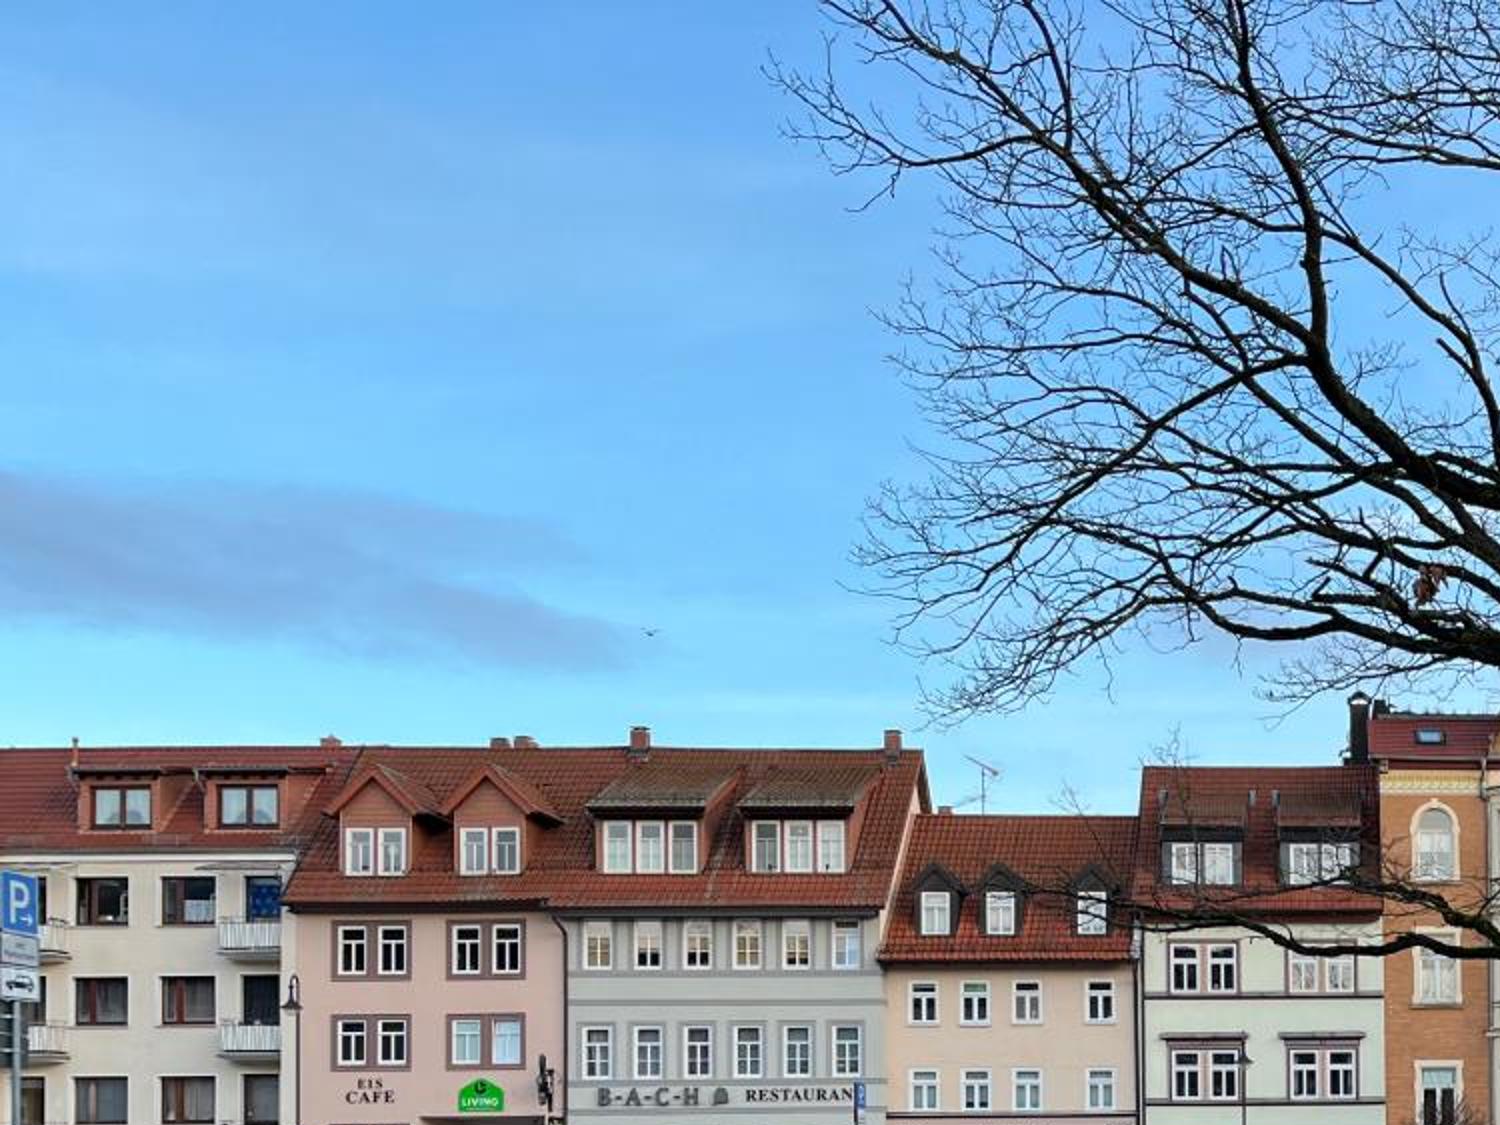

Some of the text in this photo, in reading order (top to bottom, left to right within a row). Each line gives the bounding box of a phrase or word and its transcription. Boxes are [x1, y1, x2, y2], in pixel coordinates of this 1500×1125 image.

[9, 879, 30, 925] P
[357, 1078, 384, 1090] EIS
[461, 1096, 500, 1108] LIVING
[597, 1087, 699, 1107] B-A-C-H
[745, 1087, 854, 1102] RESTAURAN
